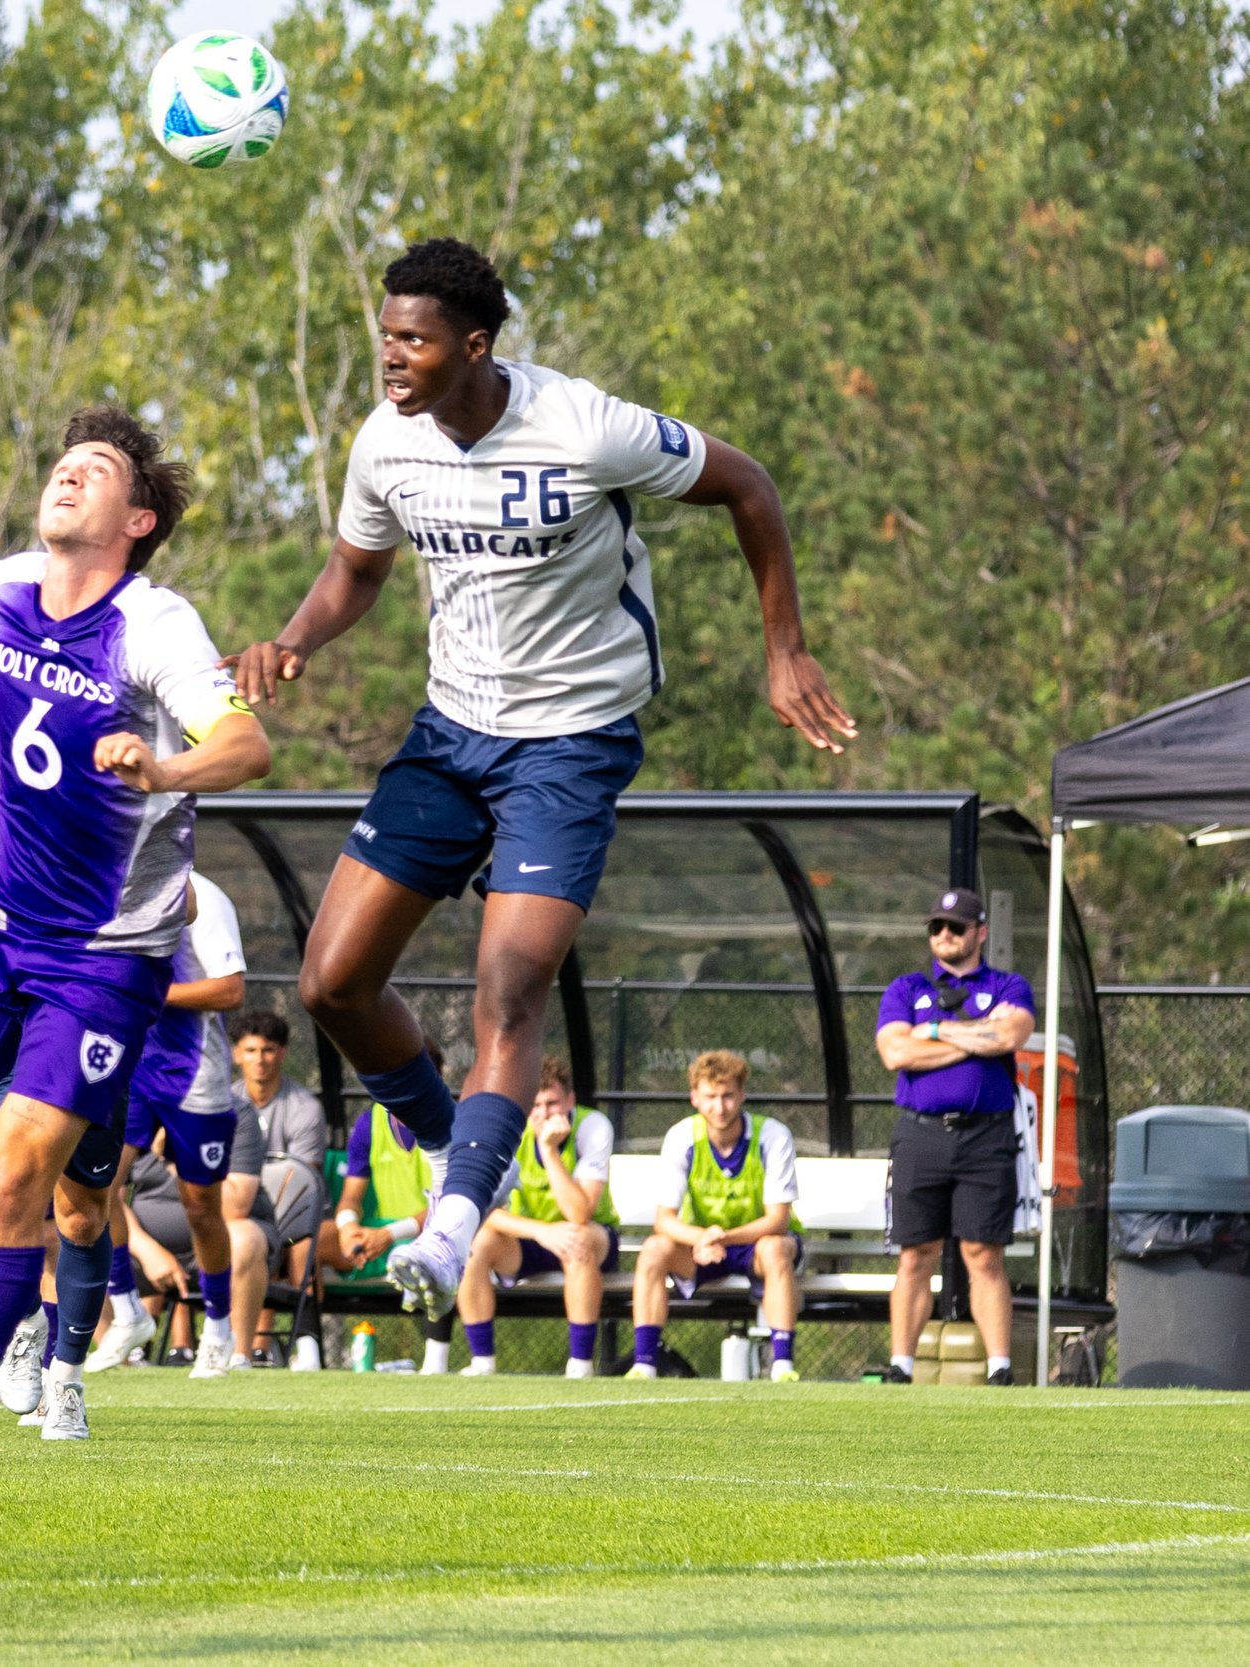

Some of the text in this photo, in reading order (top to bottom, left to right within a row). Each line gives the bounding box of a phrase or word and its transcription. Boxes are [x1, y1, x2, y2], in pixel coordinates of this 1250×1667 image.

[501, 467, 573, 528] 26
[40, 662, 116, 705] CROSS
[11, 697, 63, 791] 6
[350, 818, 377, 840] NH
